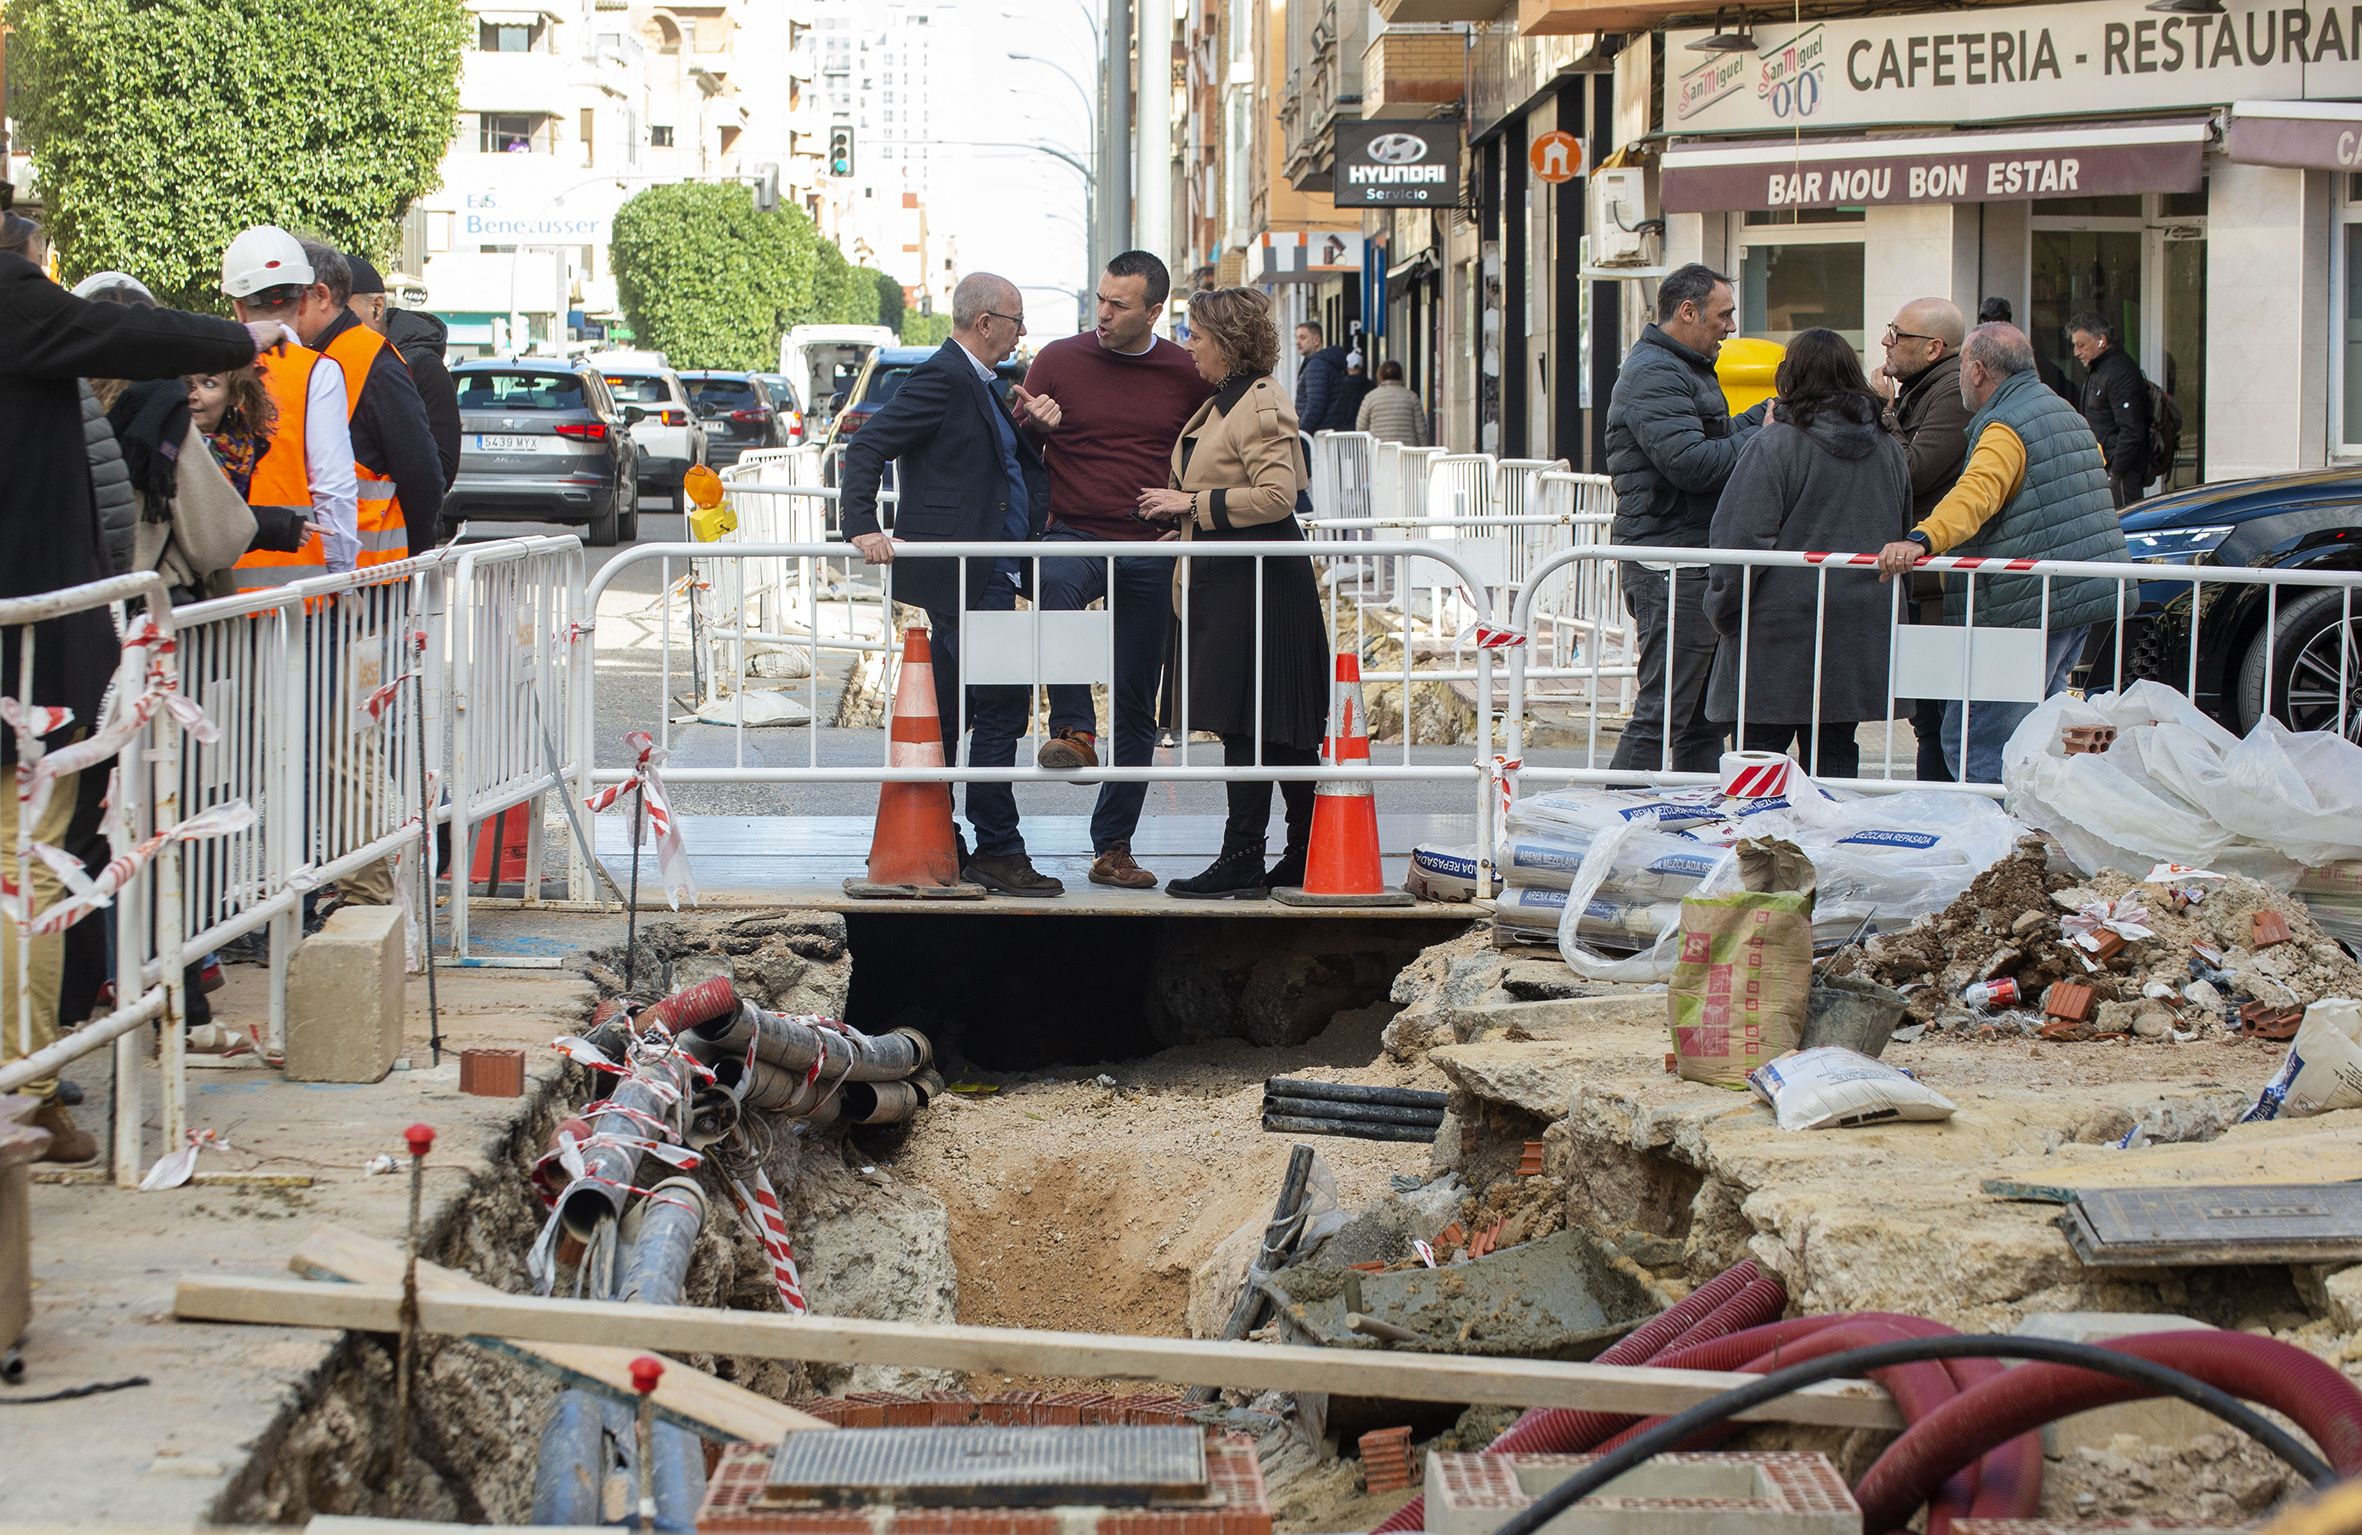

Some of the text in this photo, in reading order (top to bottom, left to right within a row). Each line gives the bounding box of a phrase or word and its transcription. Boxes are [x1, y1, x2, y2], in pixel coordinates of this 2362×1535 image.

[1846, 27, 2063, 92] CAFETERIA
[1349, 164, 1446, 184] HYUNDAI
[1767, 158, 2080, 206] BAR NOU BON ESTAR
[1366, 187, 1428, 201] Servicio
[485, 437, 537, 448] 5439 MYX
[1893, 833, 1931, 845] REPASADA
[1416, 853, 1461, 872] REPASADA
[1519, 850, 1579, 868] ARENA MEZCLADA
[1663, 858, 1701, 873] MEZCLADA
[1525, 890, 1547, 901] ARENA
